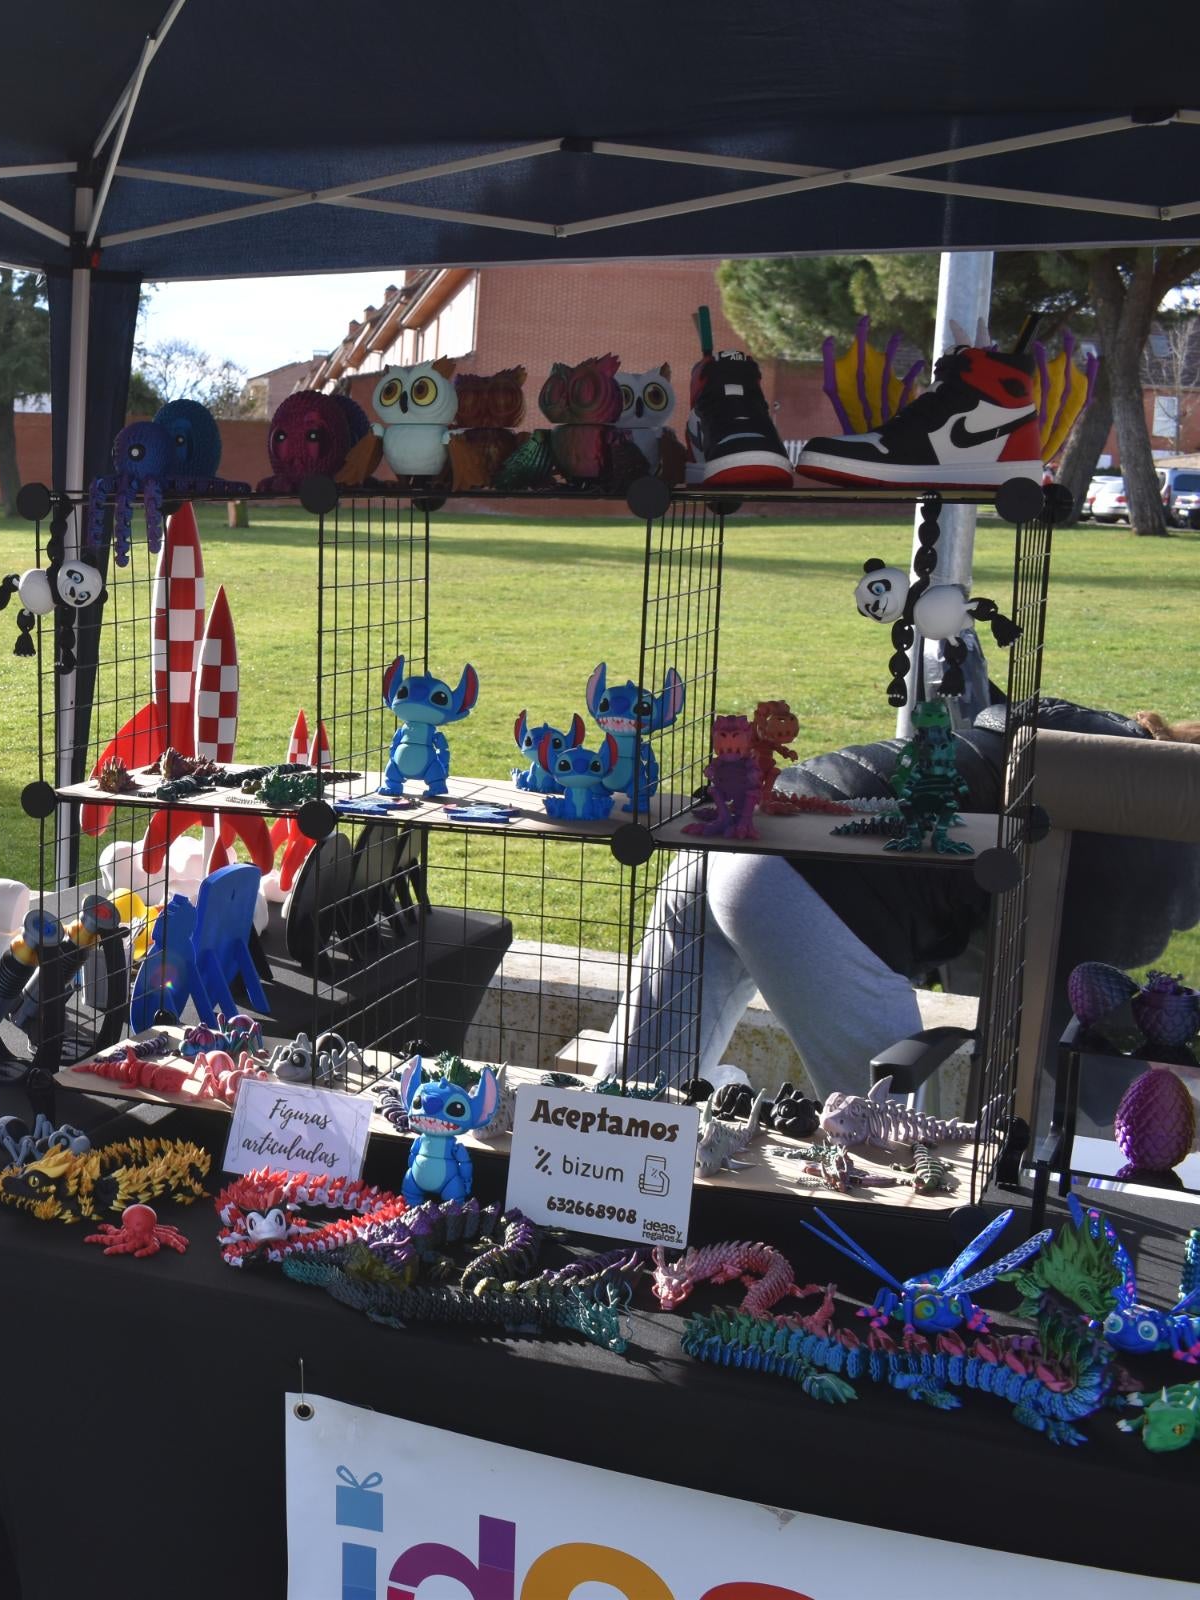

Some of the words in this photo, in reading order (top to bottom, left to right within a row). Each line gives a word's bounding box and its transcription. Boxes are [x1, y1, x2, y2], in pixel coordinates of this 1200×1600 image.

[268, 1098, 331, 1130] Figuras
[529, 1099, 680, 1143] Aceptamos
[242, 1132, 340, 1168] articuladas
[562, 1154, 624, 1183] bizum
[546, 1195, 638, 1225] 632668908
[643, 1219, 676, 1234] ideas
